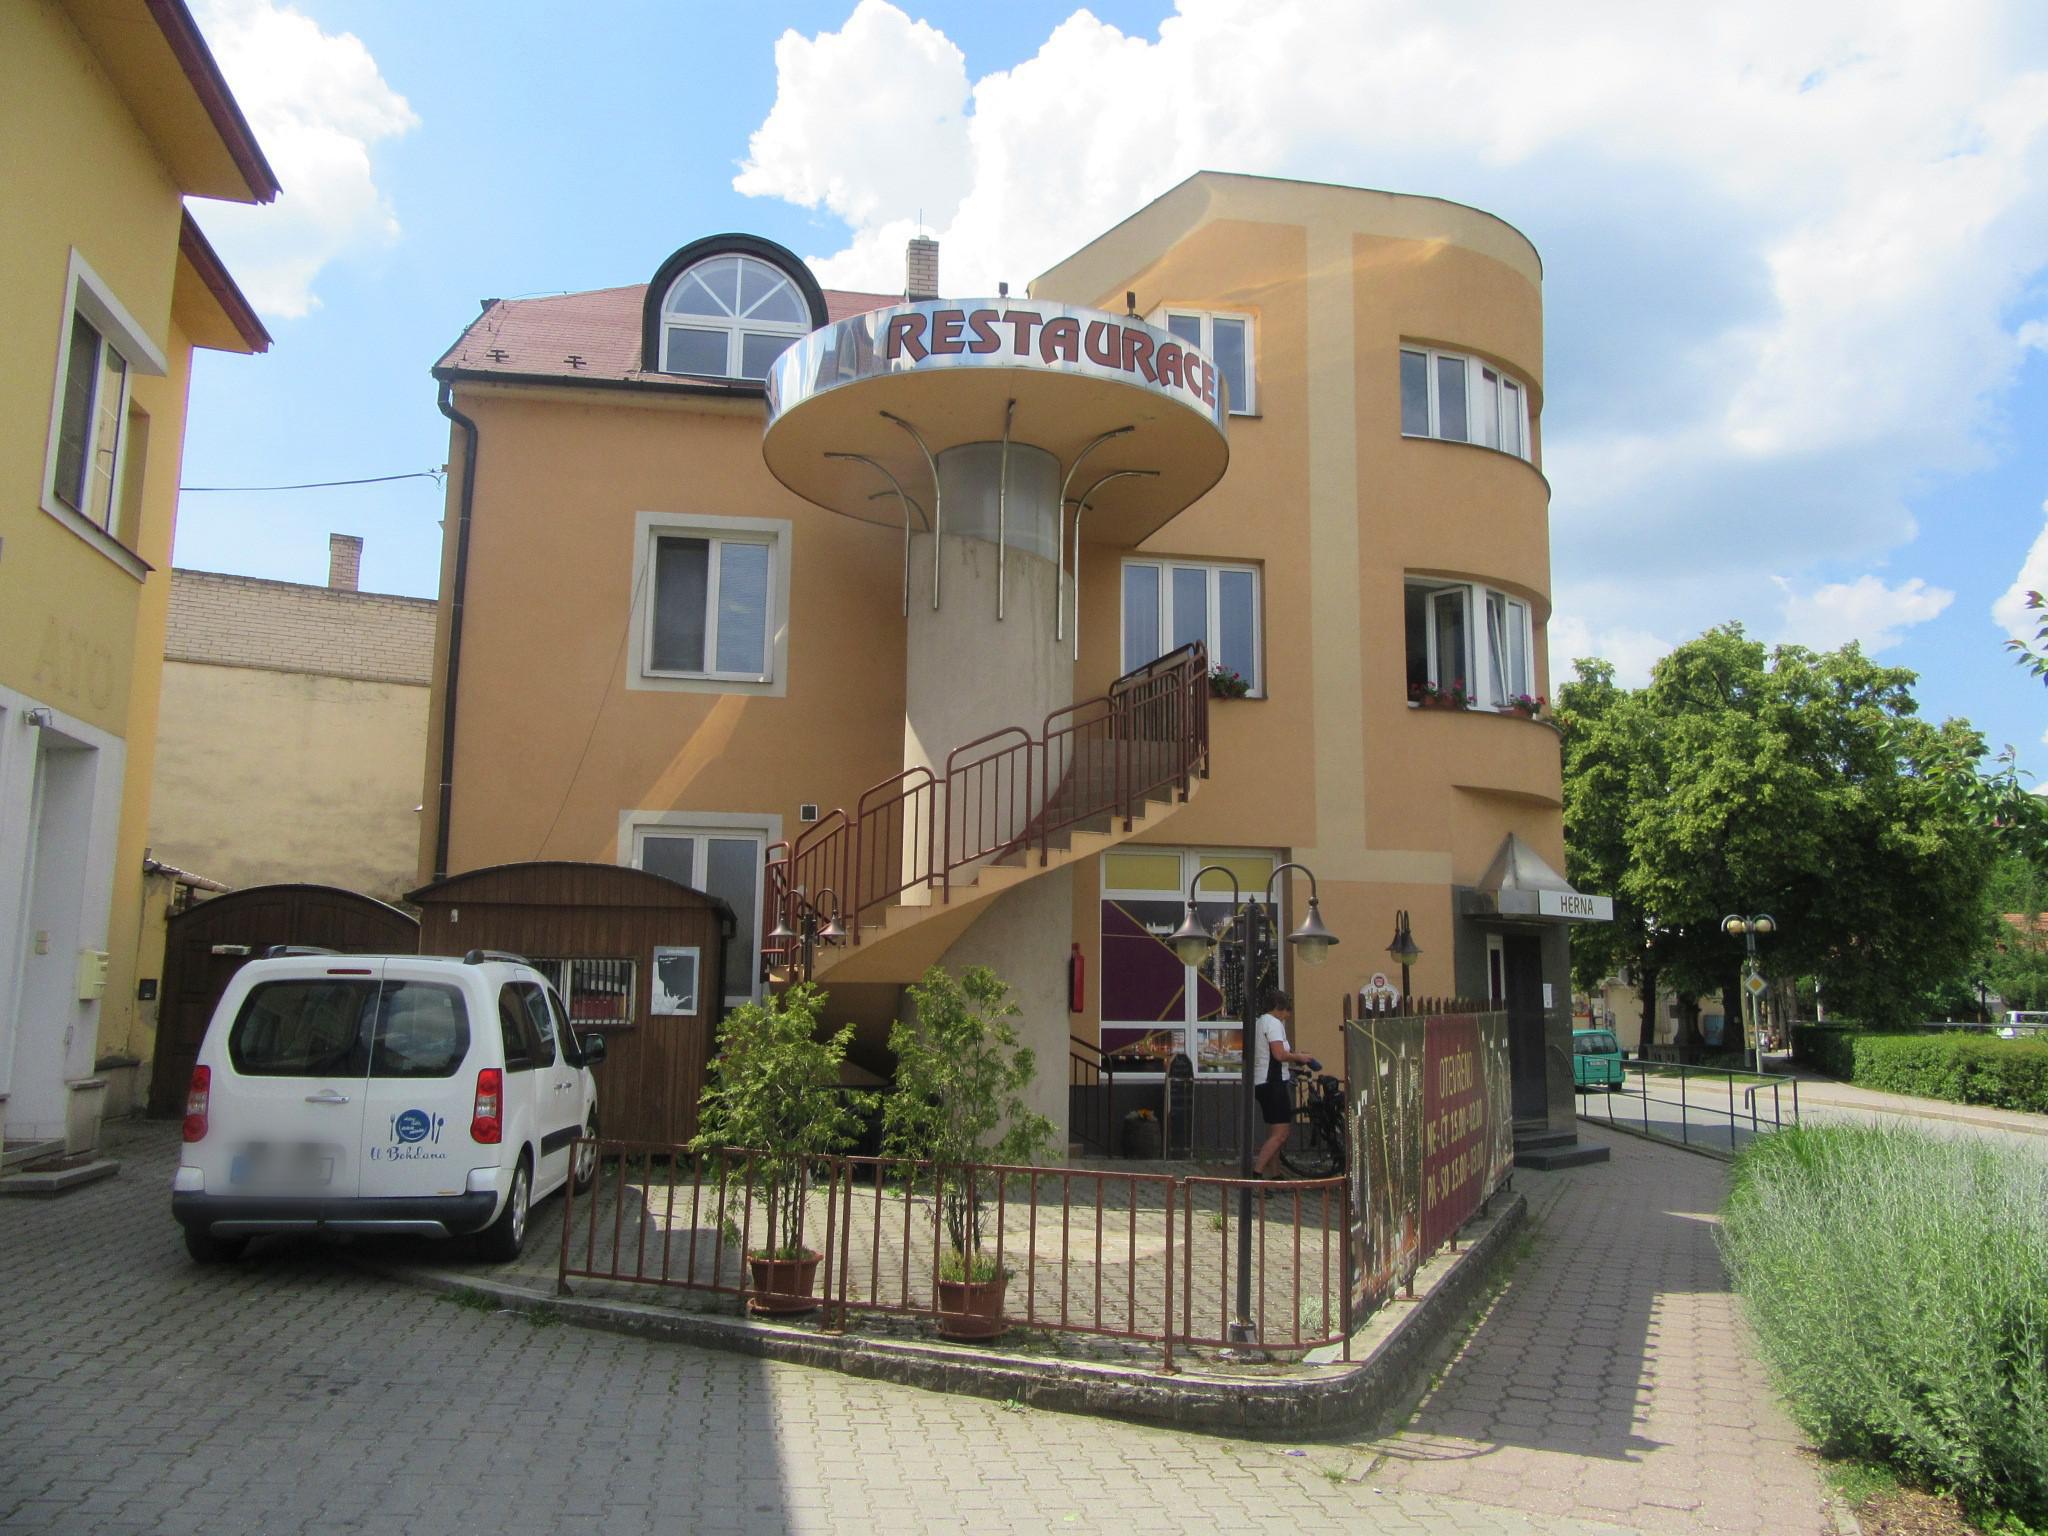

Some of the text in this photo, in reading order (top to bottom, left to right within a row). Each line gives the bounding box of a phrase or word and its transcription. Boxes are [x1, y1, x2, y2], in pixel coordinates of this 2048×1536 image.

[887, 309, 1216, 408] RESTAURACE
[1560, 896, 1594, 915] HERNA
[1439, 1045, 1473, 1098] OTEVŘENO
[387, 1146, 448, 1161] Bohdana
[1427, 1120, 1437, 1157] NE
[1441, 1109, 1449, 1149] ČT
[1441, 1164, 1450, 1200] SO
